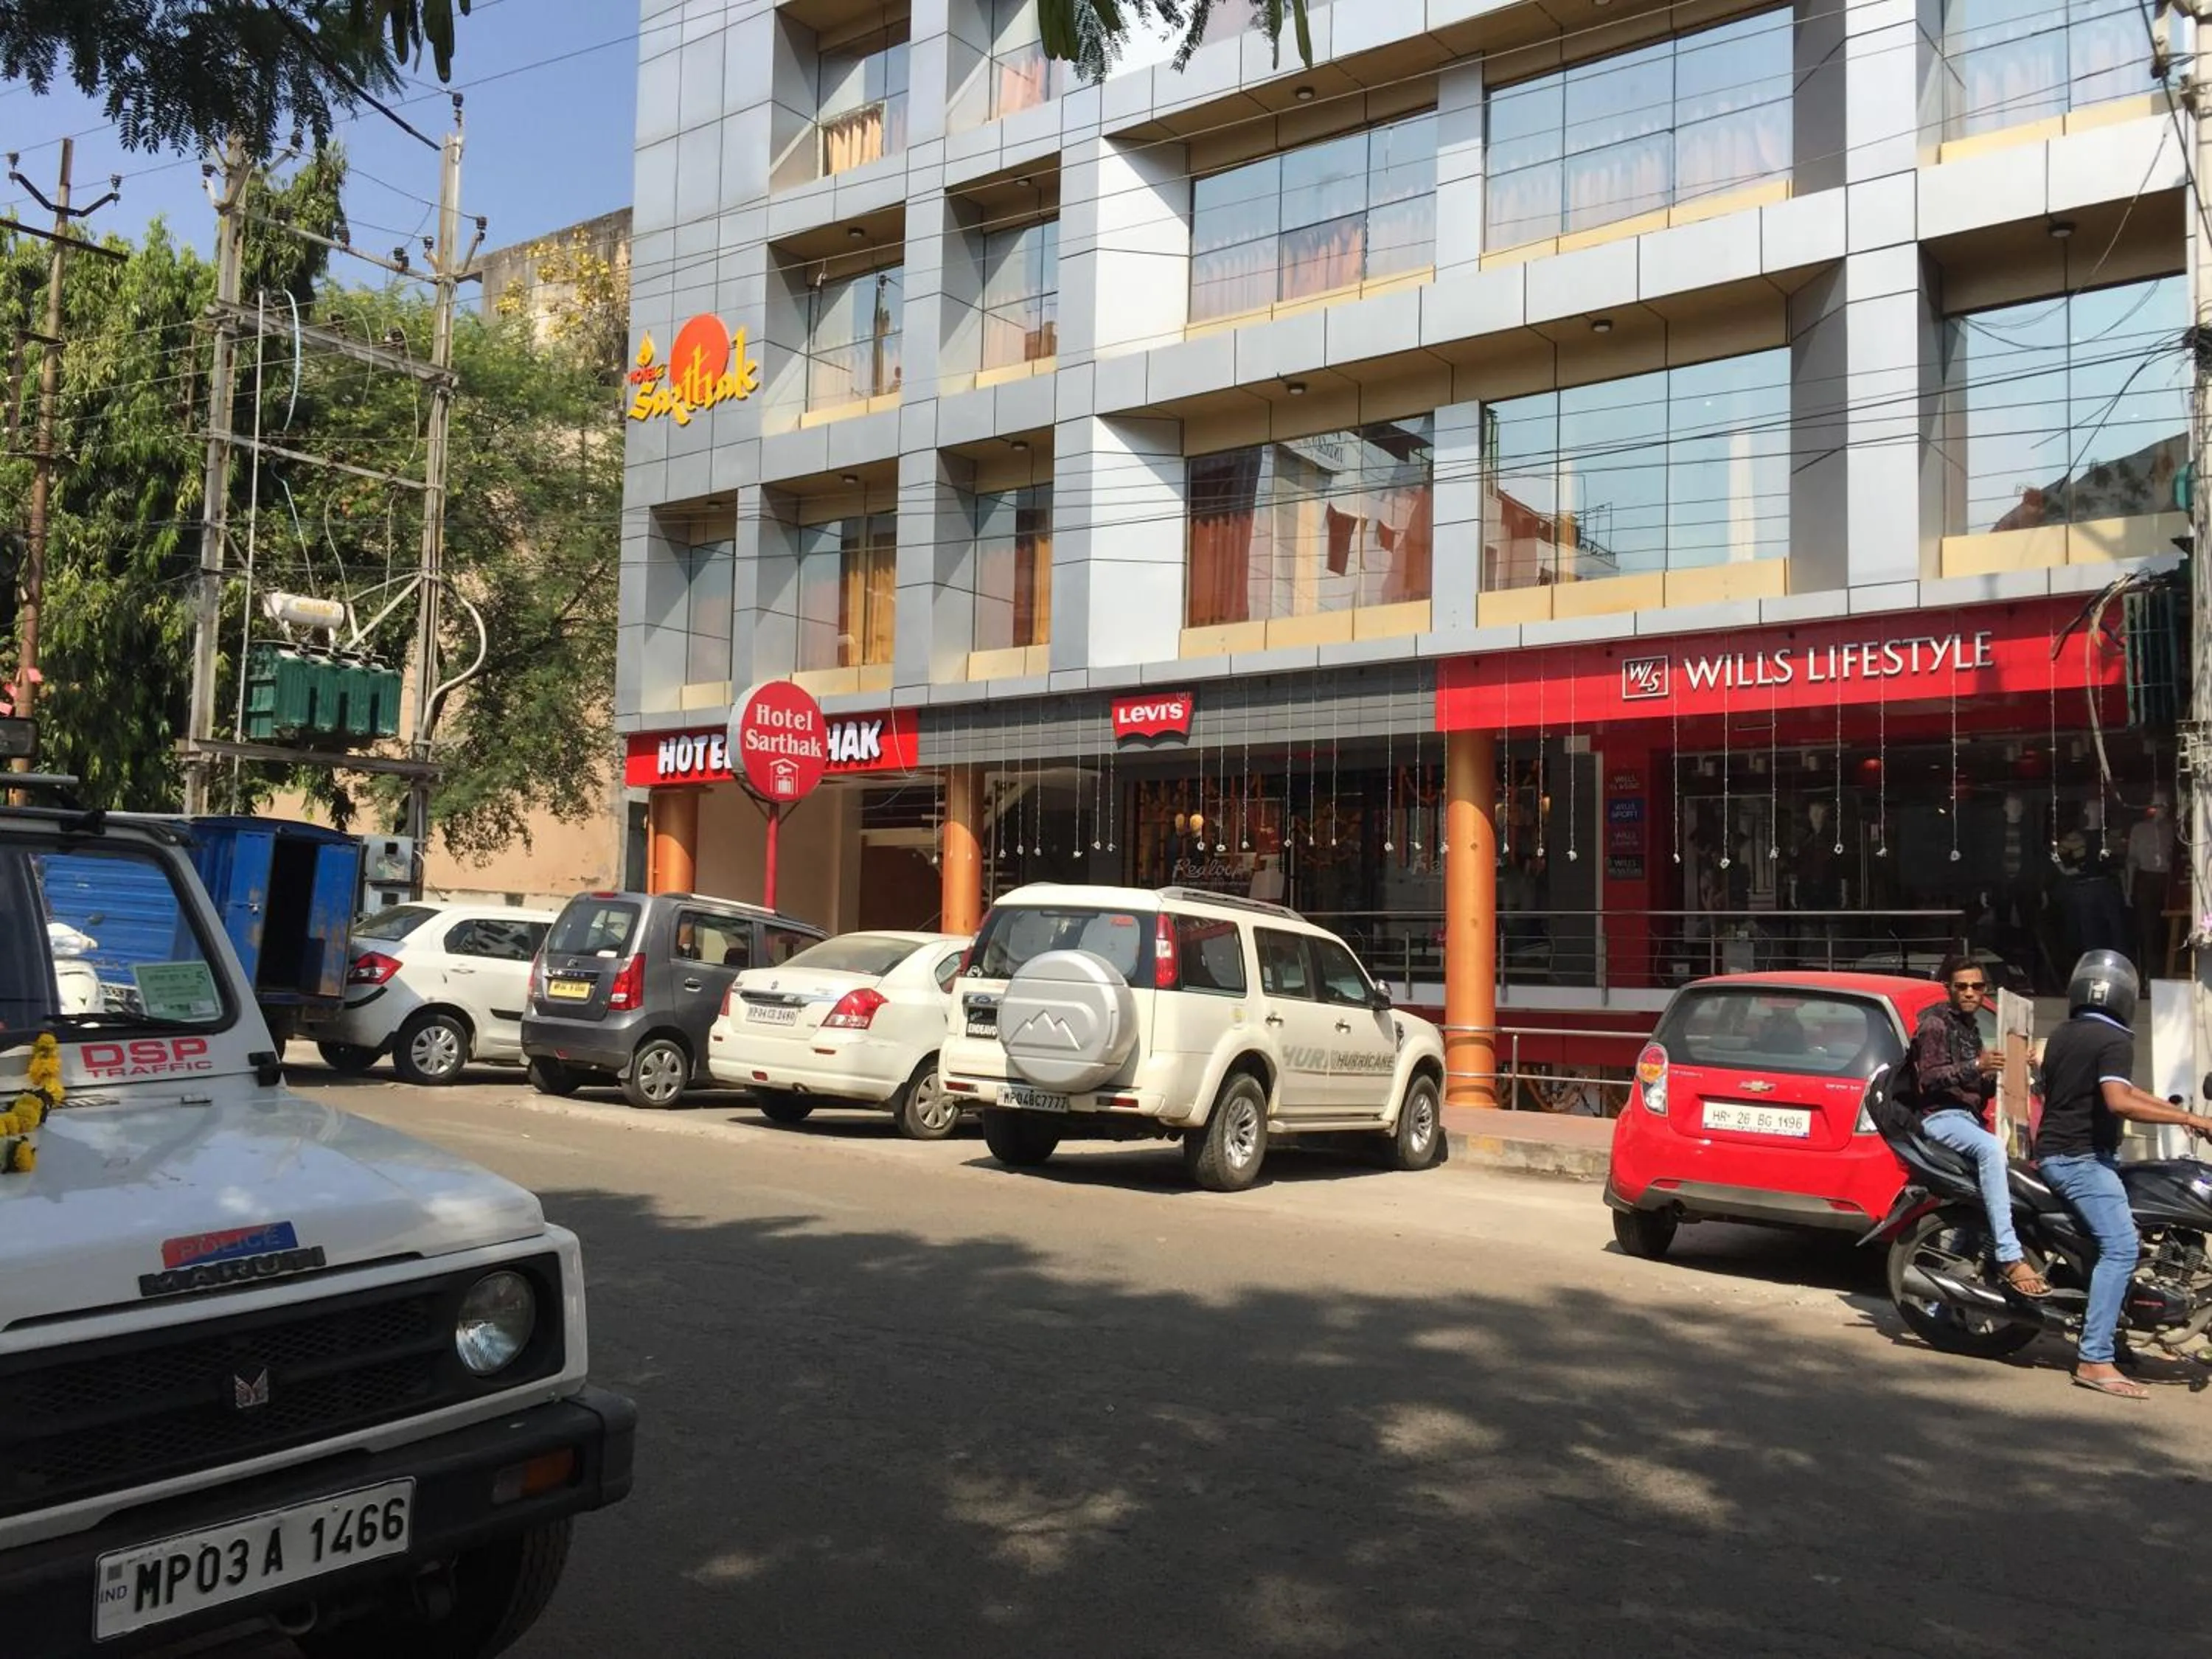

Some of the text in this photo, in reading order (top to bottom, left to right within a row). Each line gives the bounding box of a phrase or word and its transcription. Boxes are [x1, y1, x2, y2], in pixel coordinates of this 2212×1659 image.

[627, 327, 759, 426] Sarthak
[1683, 631, 1994, 689] WILLS LIFESTYLE
[755, 703, 813, 731] Hotel
[745, 728, 823, 758] Sarthak
[80, 1037, 208, 1068] DSP
[86, 1060, 213, 1079] TRAFFIC
[180, 1228, 282, 1258] POLICE
[310, 1498, 406, 1562] 1466
[100, 1585, 128, 1604] IND
